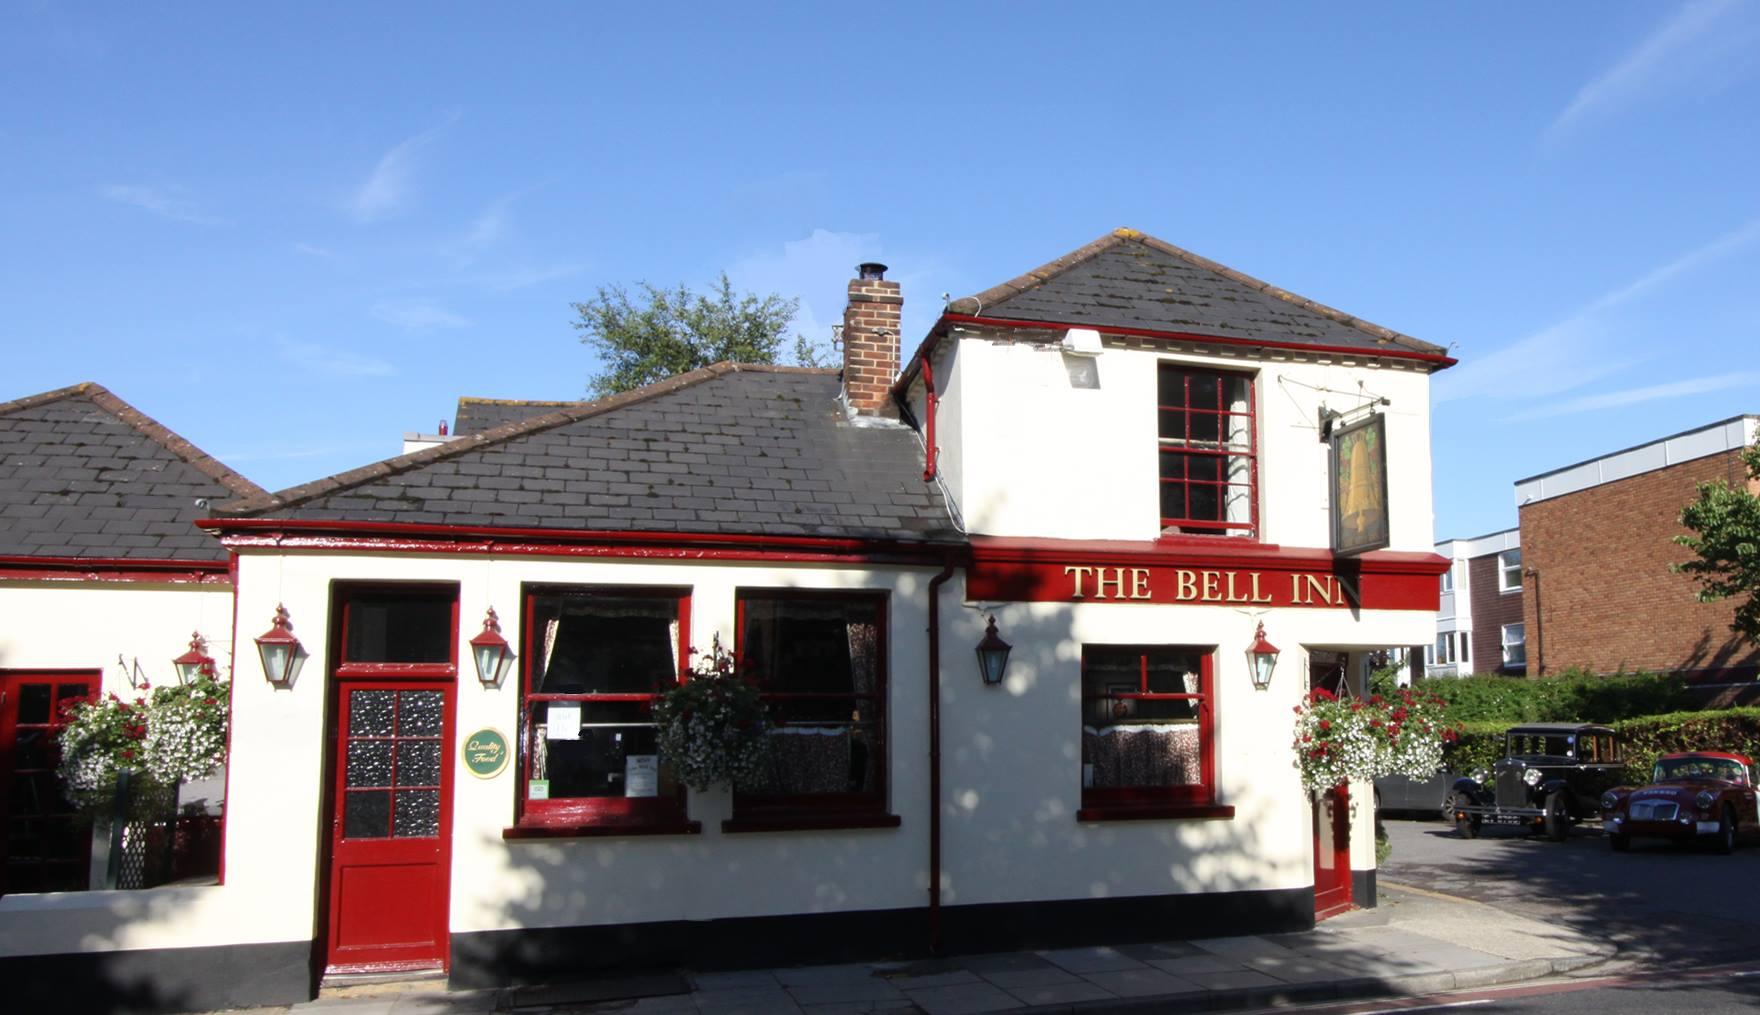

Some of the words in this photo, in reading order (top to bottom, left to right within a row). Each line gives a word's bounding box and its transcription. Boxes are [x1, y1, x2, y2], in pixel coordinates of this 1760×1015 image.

[1064, 565, 1152, 600] THE
[1174, 569, 1272, 604] BELL
[1290, 574, 1364, 608] INN
